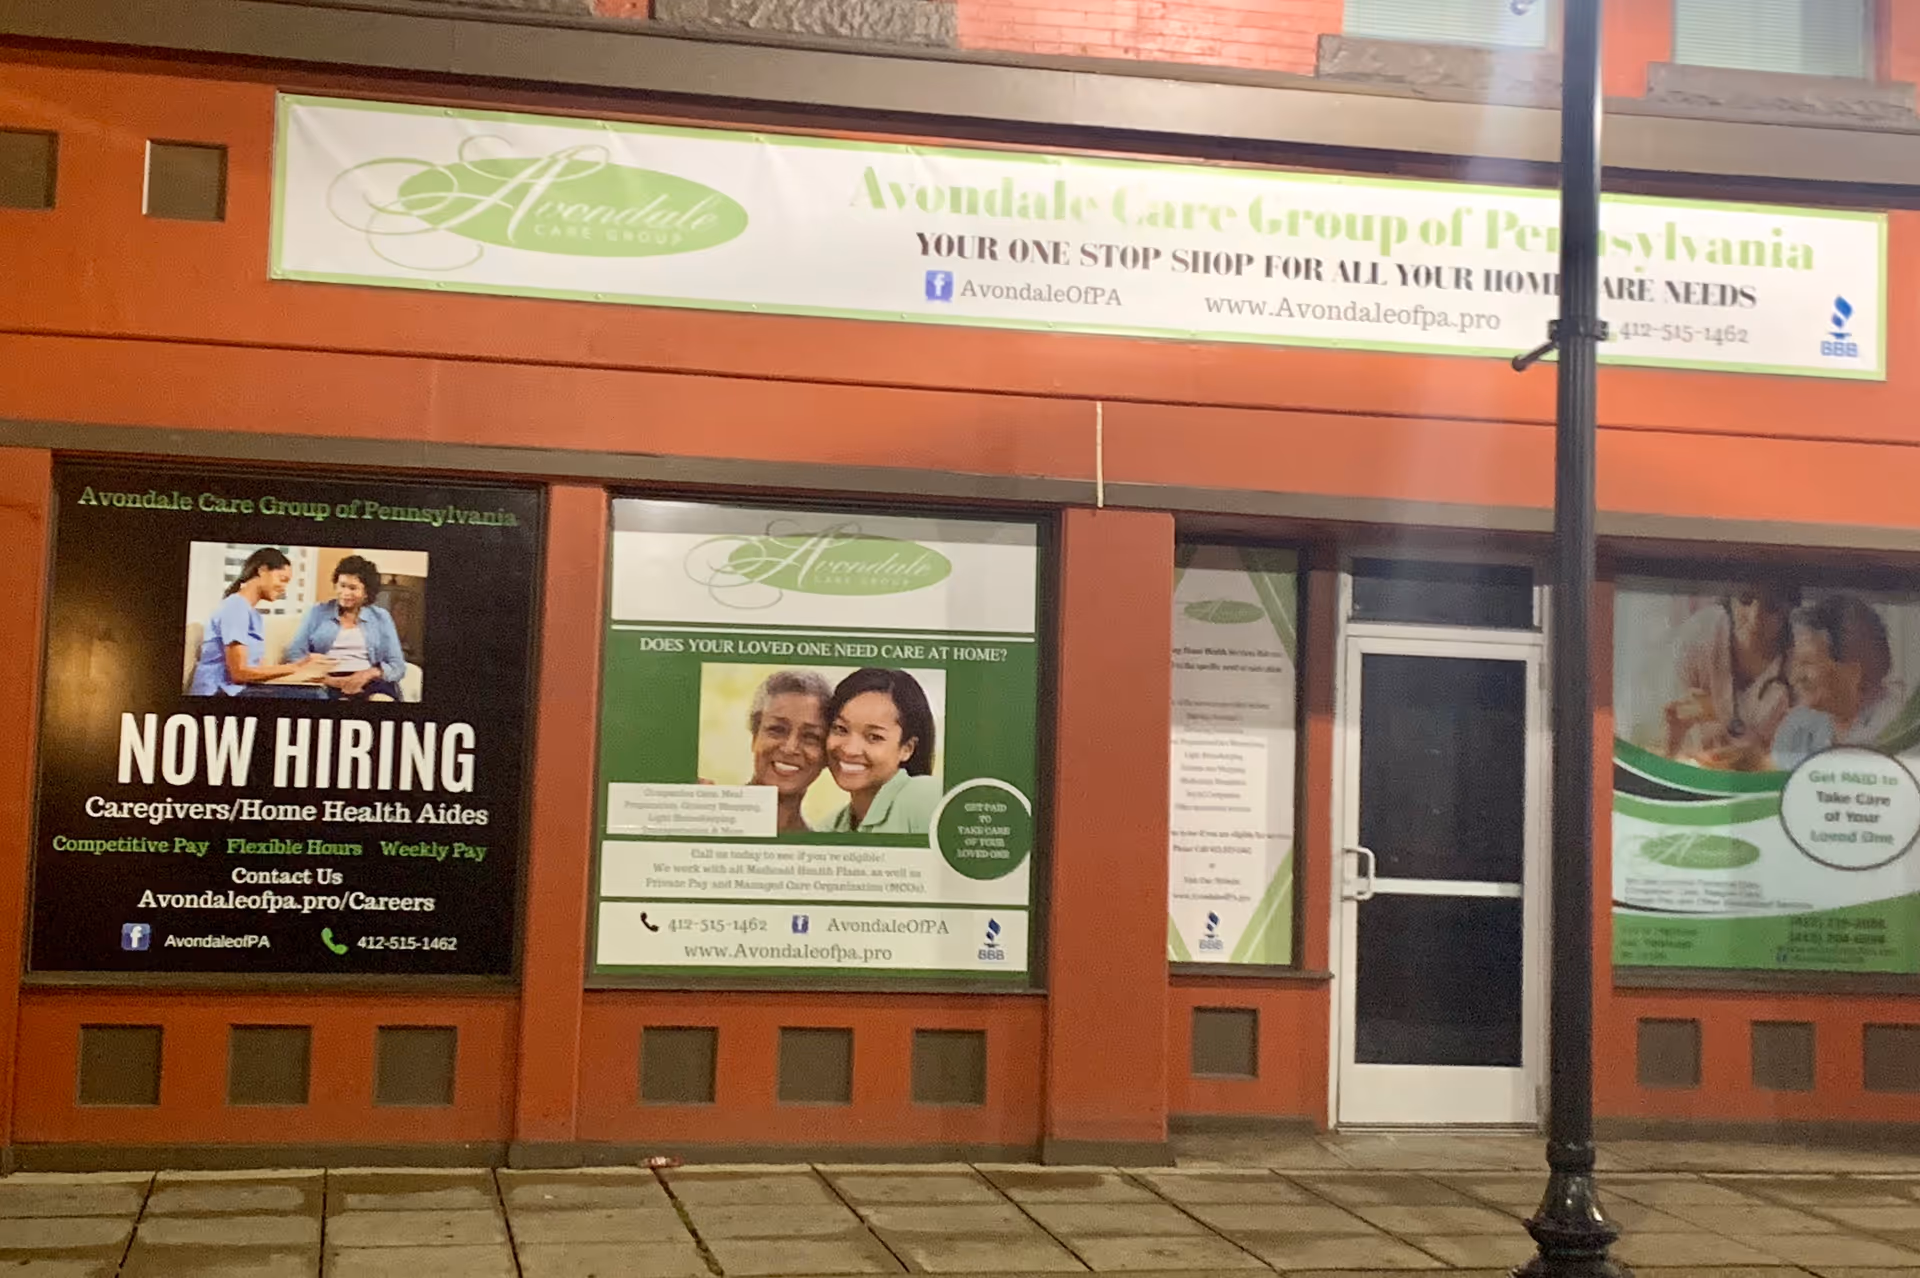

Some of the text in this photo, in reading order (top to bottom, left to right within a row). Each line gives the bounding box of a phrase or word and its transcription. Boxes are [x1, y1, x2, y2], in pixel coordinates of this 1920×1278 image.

[365, 138, 722, 262] Avondale
[849, 166, 1815, 272] Avondale Care Group of Pesylvania
[534, 224, 684, 245] CARE GROUP
[916, 232, 999, 261] YOUR
[1008, 238, 1070, 266] ONE
[1079, 242, 1162, 271] STOP
[1171, 248, 1255, 277] SHOP
[1263, 255, 1323, 283] FOR
[1336, 259, 1388, 287] ALL
[1395, 262, 1474, 292] YOUR
[1602, 275, 1655, 303] ARE
[1663, 280, 1757, 309] NEEDS
[960, 278, 1123, 307] AvondaleOfPA
[1204, 294, 1501, 333] www.Avondaleofpa.pro
[1619, 322, 1748, 346] 412-515-1462
[1820, 340, 1858, 358] BBB
[78, 486, 520, 527] Avondale Care Group of Pennsylvania
[710, 520, 932, 600] Avondale
[639, 637, 1007, 662] DOES YOUR LOVED ONE NEED CARE AT HOME?
[118, 712, 476, 793] NOW HIRING
[1808, 770, 1835, 783] Get
[1816, 791, 1891, 807] Take Care
[85, 796, 488, 826] Caregivers/Home Health Aides
[1824, 811, 1880, 824] of Your
[53, 835, 209, 858] Competitive Pay
[226, 839, 363, 857] Flexible Hours
[380, 840, 487, 862] Weekly Pay
[231, 867, 343, 886] Contact Us
[137, 889, 435, 915] Avondaleofpa.pro/Careers
[668, 917, 768, 933] 412-515-1462
[827, 917, 950, 935] AvondaleOfPA
[164, 933, 271, 950] AvondaleofPA
[356, 935, 458, 952] 412-515-1462
[684, 943, 893, 963] www.Avondaleofpa.pro
[977, 949, 1005, 961] BBB
